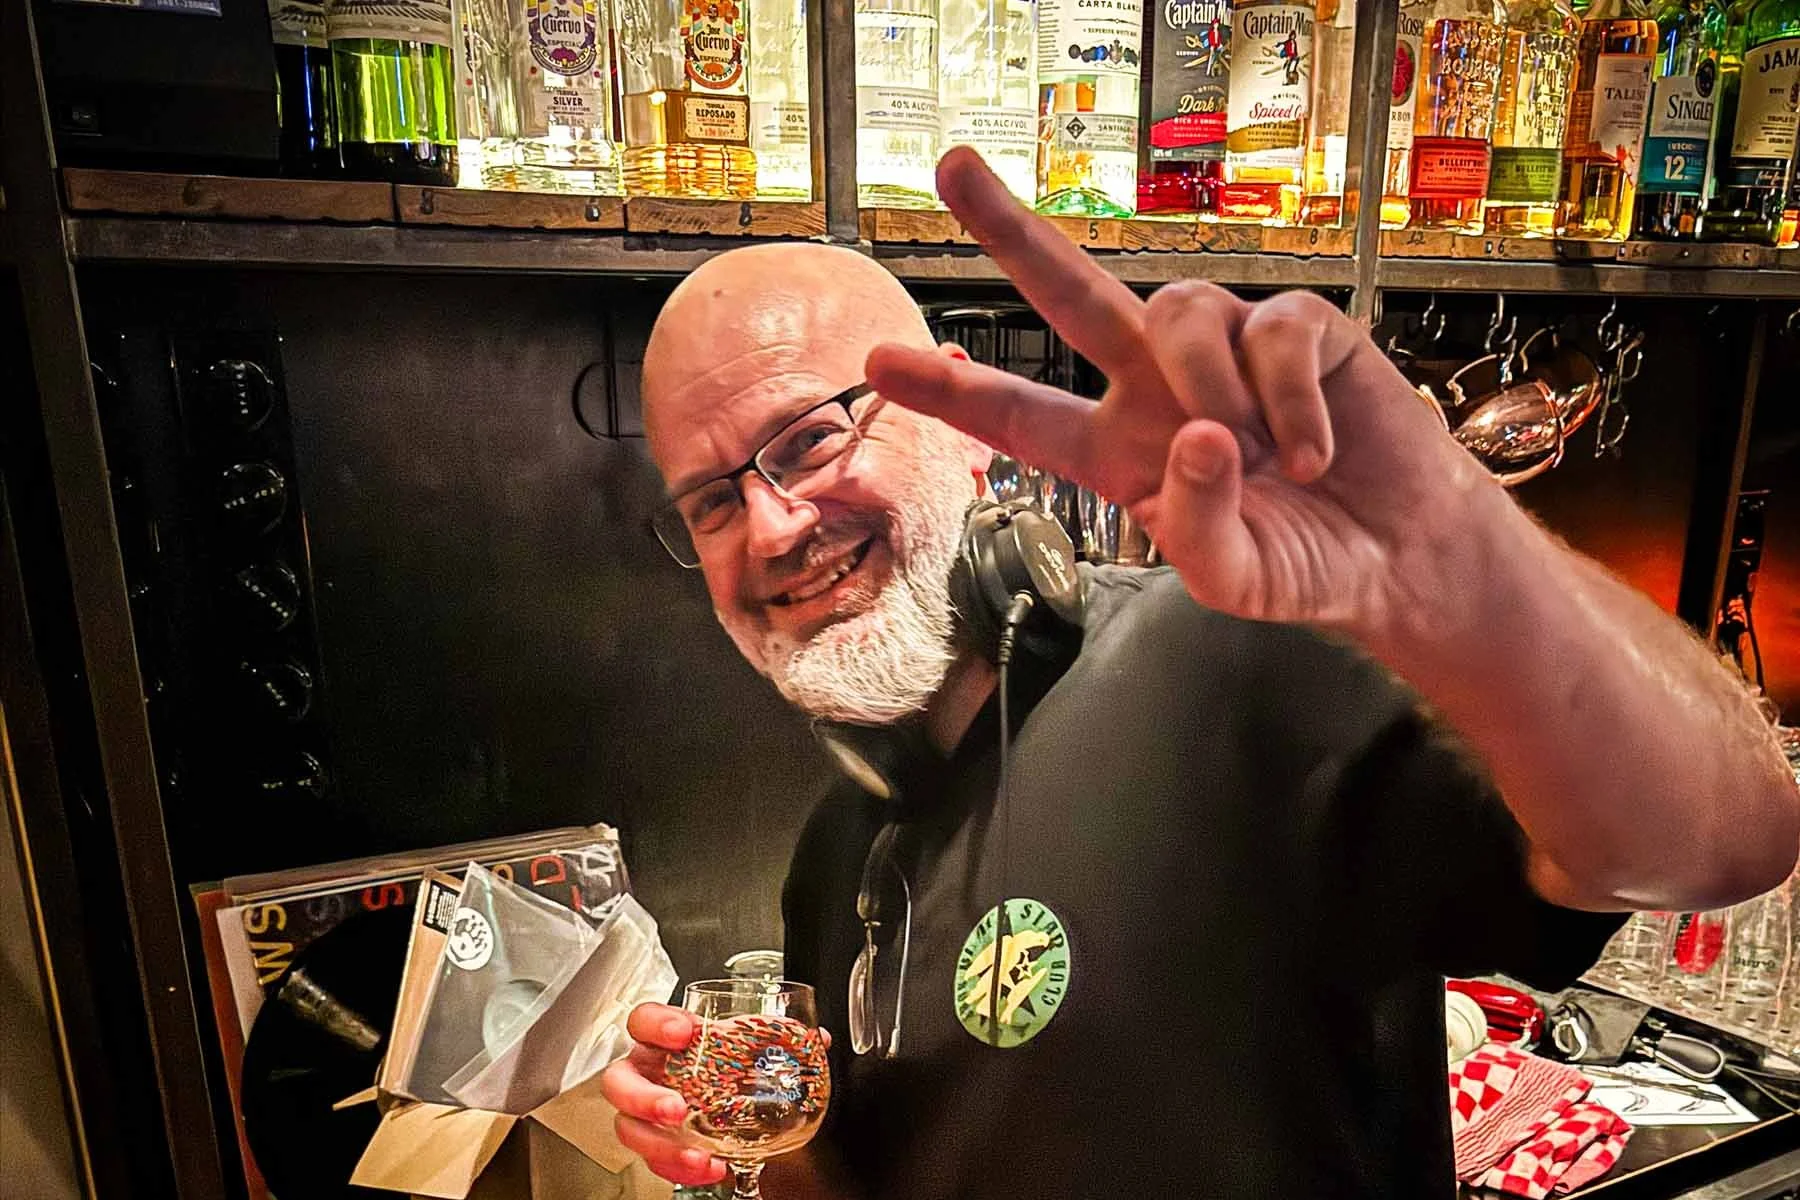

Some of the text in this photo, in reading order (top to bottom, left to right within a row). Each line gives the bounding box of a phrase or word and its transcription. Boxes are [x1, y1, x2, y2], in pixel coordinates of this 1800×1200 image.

[1078, 0, 1113, 8] CARTA
[553, 6, 570, 18] Jose
[1165, 0, 1211, 30] Captain
[542, 14, 581, 35] Cuervo
[706, 24, 720, 35] Jose
[1243, 10, 1292, 40] Captain
[546, 39, 582, 48] ESPECIAL
[695, 31, 729, 51] Cuervo
[699, 55, 730, 63] ESPECIAL
[553, 96, 583, 106] SILVER
[890, 100, 909, 109] 40%
[1177, 94, 1214, 113] Dark
[695, 109, 735, 119] REPOSADO
[1249, 102, 1291, 120] Spiced
[785, 114, 804, 122] 40%
[972, 118, 1027, 129] 40% ALC/VOL
[1664, 155, 1685, 180] 12
[1088, 223, 1099, 240] 5
[1041, 959, 1066, 1007] CLUB
